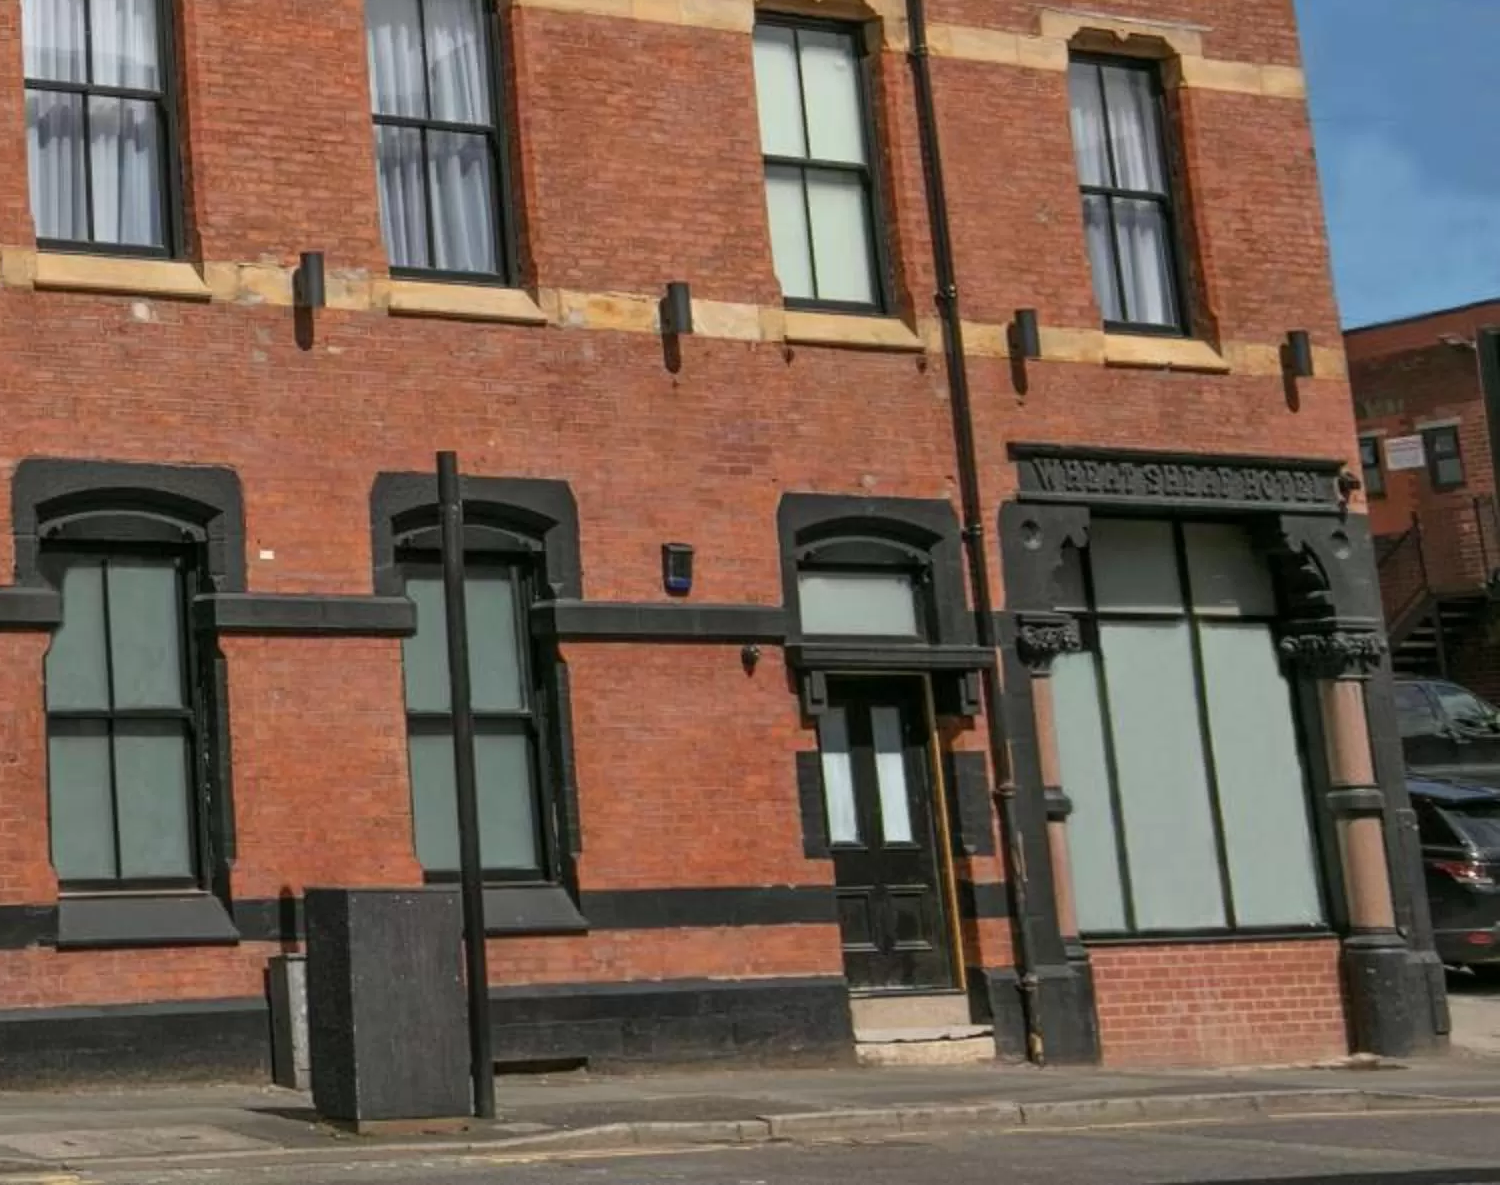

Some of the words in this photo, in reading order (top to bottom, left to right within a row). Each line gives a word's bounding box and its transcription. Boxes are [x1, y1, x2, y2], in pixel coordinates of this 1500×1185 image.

[1031, 458, 1135, 495] WHEAT
[1143, 462, 1233, 499] SHEAF
[1240, 467, 1327, 503] HOTEL
